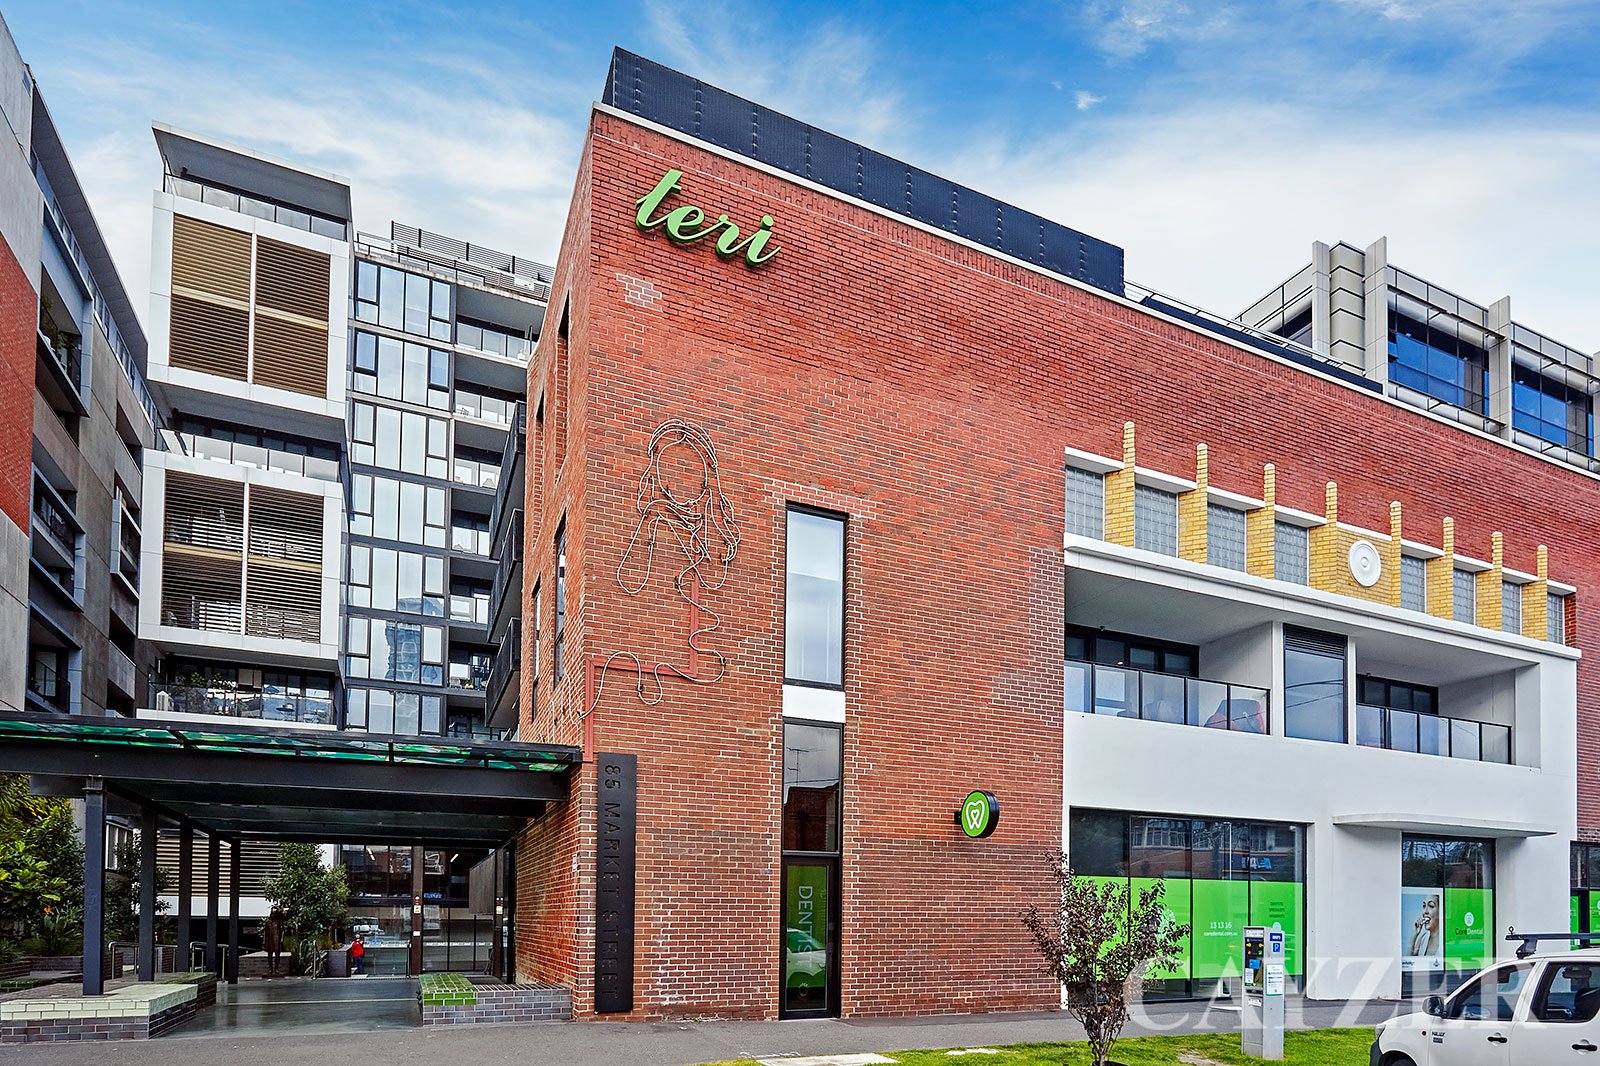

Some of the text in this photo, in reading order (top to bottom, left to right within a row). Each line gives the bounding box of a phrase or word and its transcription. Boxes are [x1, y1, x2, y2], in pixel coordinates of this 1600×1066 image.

[635, 168, 782, 267] teri
[602, 764, 621, 999] 85 MARKET STREET
[798, 885, 813, 968] DENTIST
